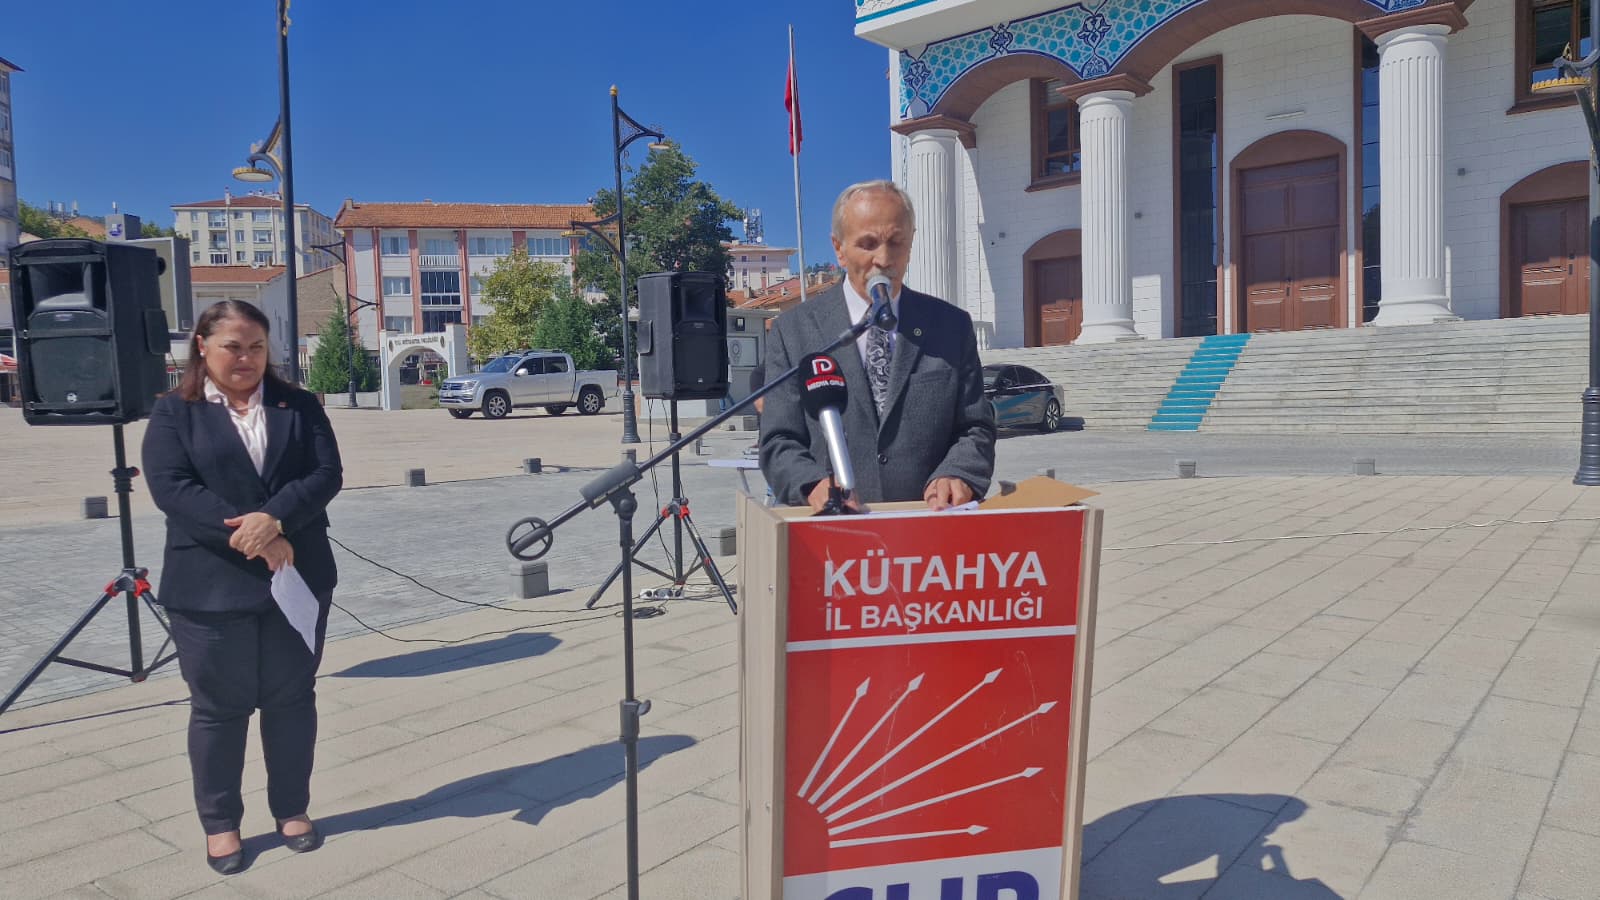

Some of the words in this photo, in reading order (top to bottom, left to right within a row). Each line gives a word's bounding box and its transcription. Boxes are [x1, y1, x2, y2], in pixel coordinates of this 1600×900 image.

[824, 549, 1048, 597] KÜTAHYA
[825, 602, 851, 631] İL
[861, 591, 1043, 632] BAŞKANLIĞI
